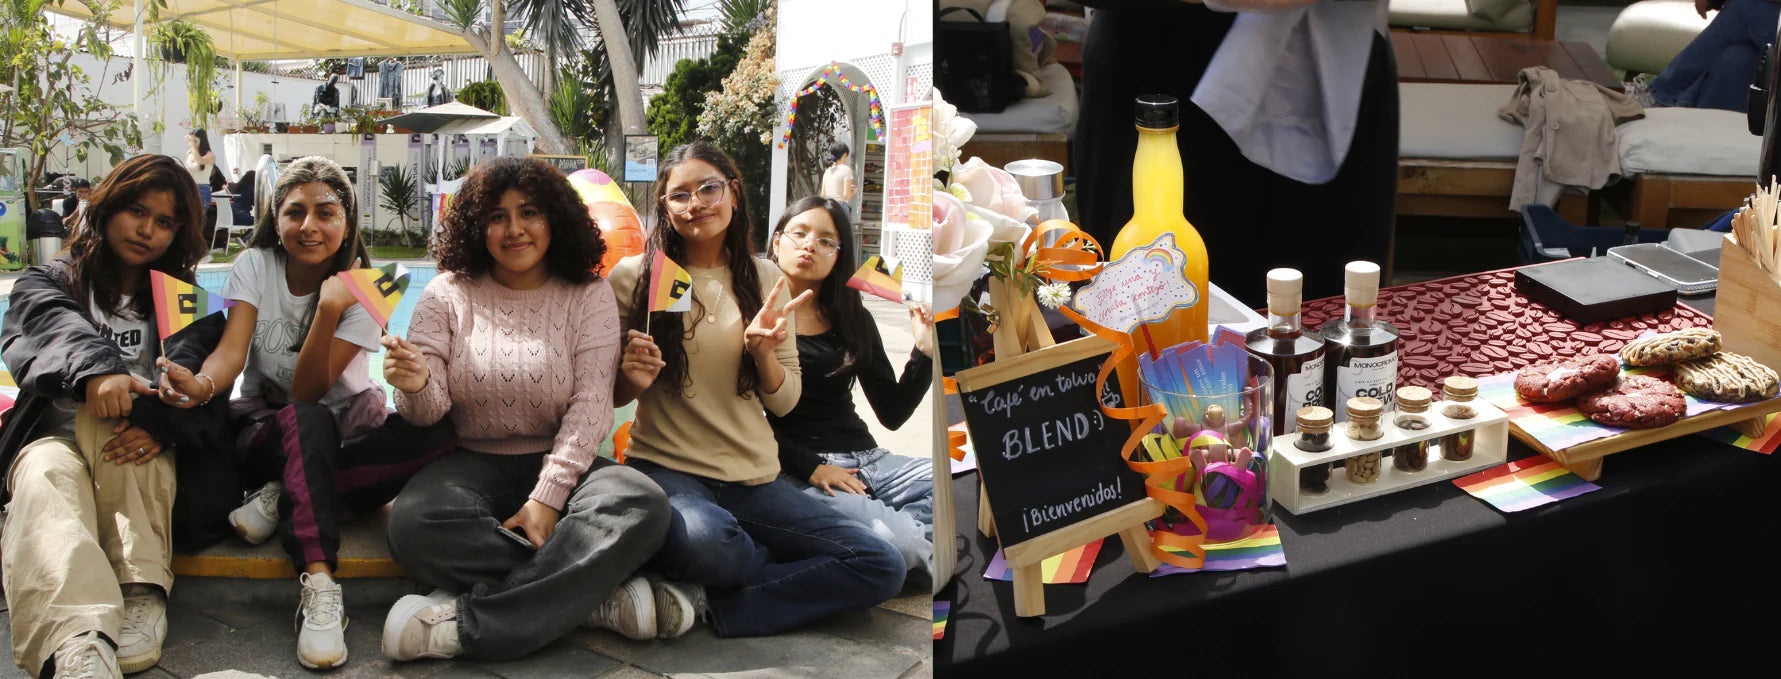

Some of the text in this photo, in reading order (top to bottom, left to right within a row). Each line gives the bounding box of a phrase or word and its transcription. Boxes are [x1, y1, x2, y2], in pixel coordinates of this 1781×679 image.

[1029, 384, 1055, 400] en
[1355, 382, 1393, 399] COLD
[1002, 412, 1090, 461] BLEND
[1023, 476, 1122, 533] ¡Bienvenidos!
